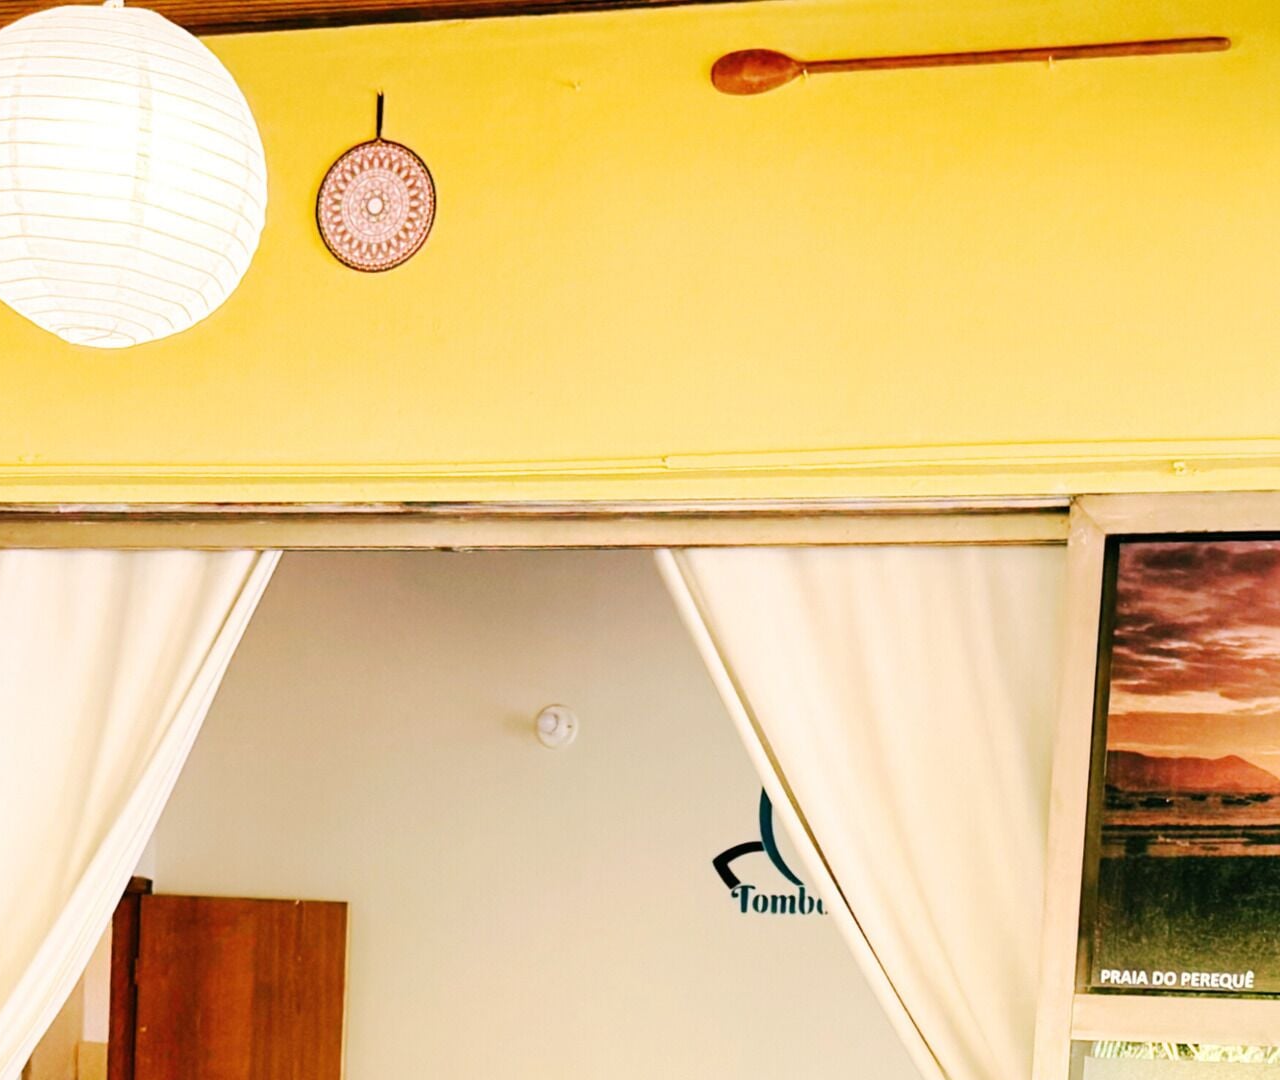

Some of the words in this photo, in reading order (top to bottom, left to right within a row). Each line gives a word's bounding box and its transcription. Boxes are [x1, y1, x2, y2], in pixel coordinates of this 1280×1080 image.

[1100, 969, 1148, 985] PRAIA
[1152, 971, 1177, 986] DO
[1180, 970, 1255, 989] PEREQUÊ
